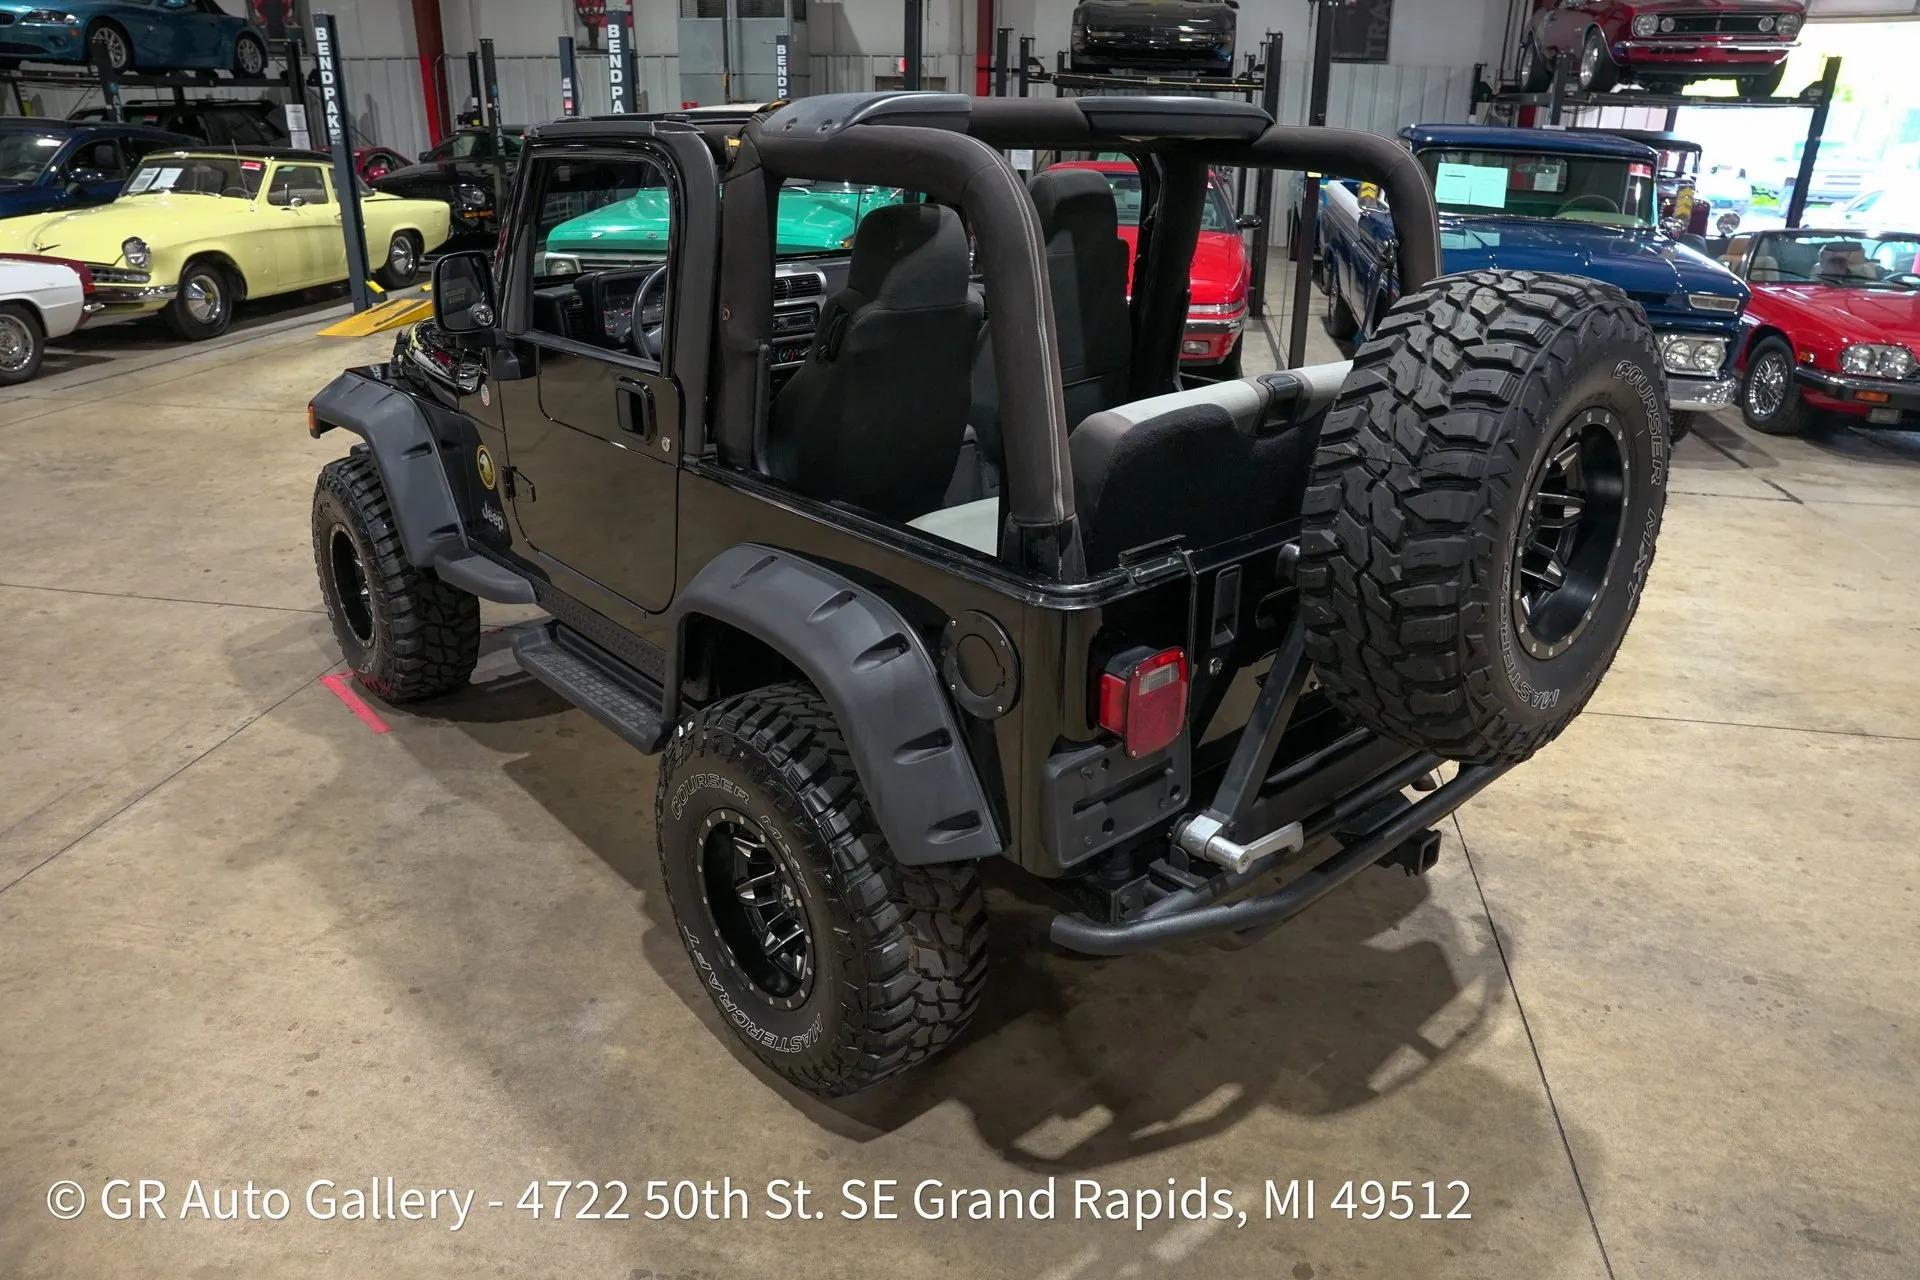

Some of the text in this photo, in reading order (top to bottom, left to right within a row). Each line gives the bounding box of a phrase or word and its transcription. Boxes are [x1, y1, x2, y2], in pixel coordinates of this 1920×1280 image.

[315, 26, 340, 129] BENDPAK
[606, 24, 625, 114] BENDPA
[776, 44, 788, 99] BENDP
[1612, 359, 1664, 488] COURSER
[480, 502, 504, 532] Jeep
[670, 772, 751, 822] COURSER
[683, 924, 826, 1056] MASTERCRAFT
